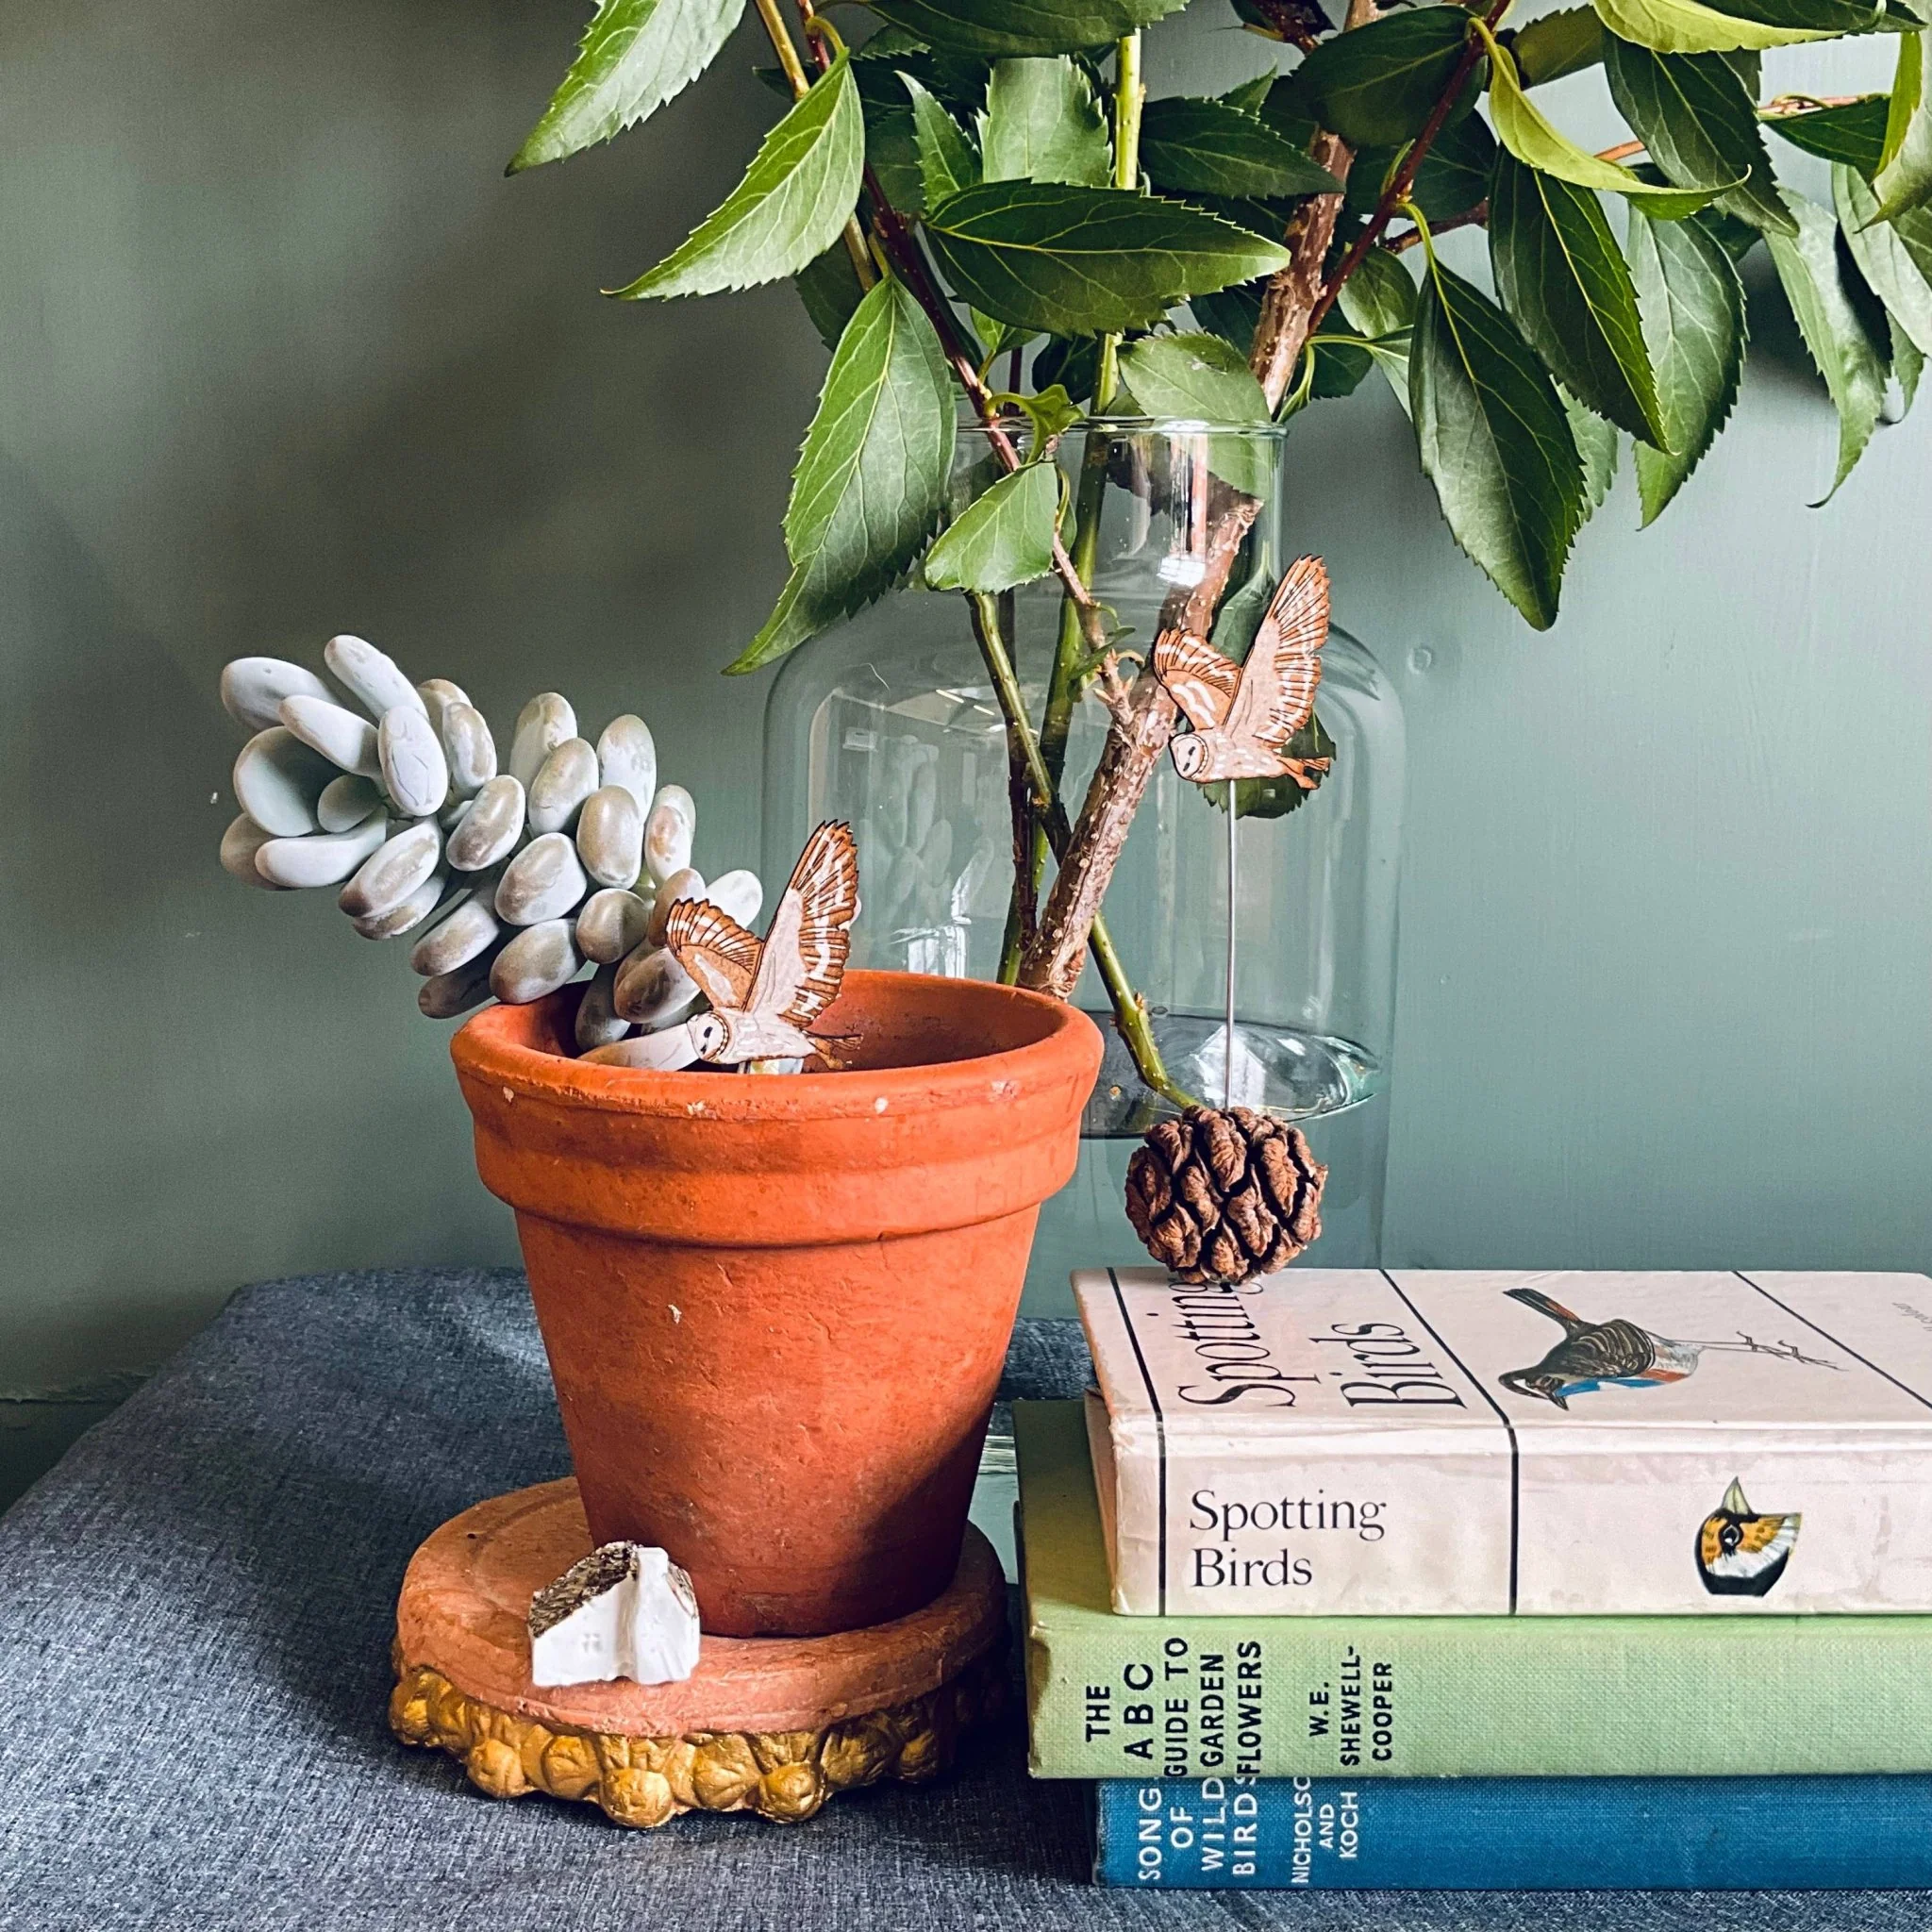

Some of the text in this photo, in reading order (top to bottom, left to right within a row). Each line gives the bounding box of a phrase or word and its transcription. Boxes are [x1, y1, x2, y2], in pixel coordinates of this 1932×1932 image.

[1308, 1323, 1468, 1409] Birds
[1190, 1489, 1387, 1541] Spotting
[1192, 1547, 1313, 1588] Birds
[1085, 1685, 1111, 1743] THE
[1163, 1637, 1190, 1777] GUIDE TO
[1199, 1653, 1224, 1768] GARDEN
[1236, 1641, 1262, 1775] FLOWERS
[1340, 1645, 1361, 1767] SHEWELL-
[1372, 1662, 1393, 1761] COOPER
[1138, 1777, 1162, 1880] SONG
[1170, 1806, 1194, 1849] OF
[1201, 1777, 1226, 1872] WILD
[1319, 1803, 1336, 1849] AND
[1339, 1791, 1359, 1858] KOCH
